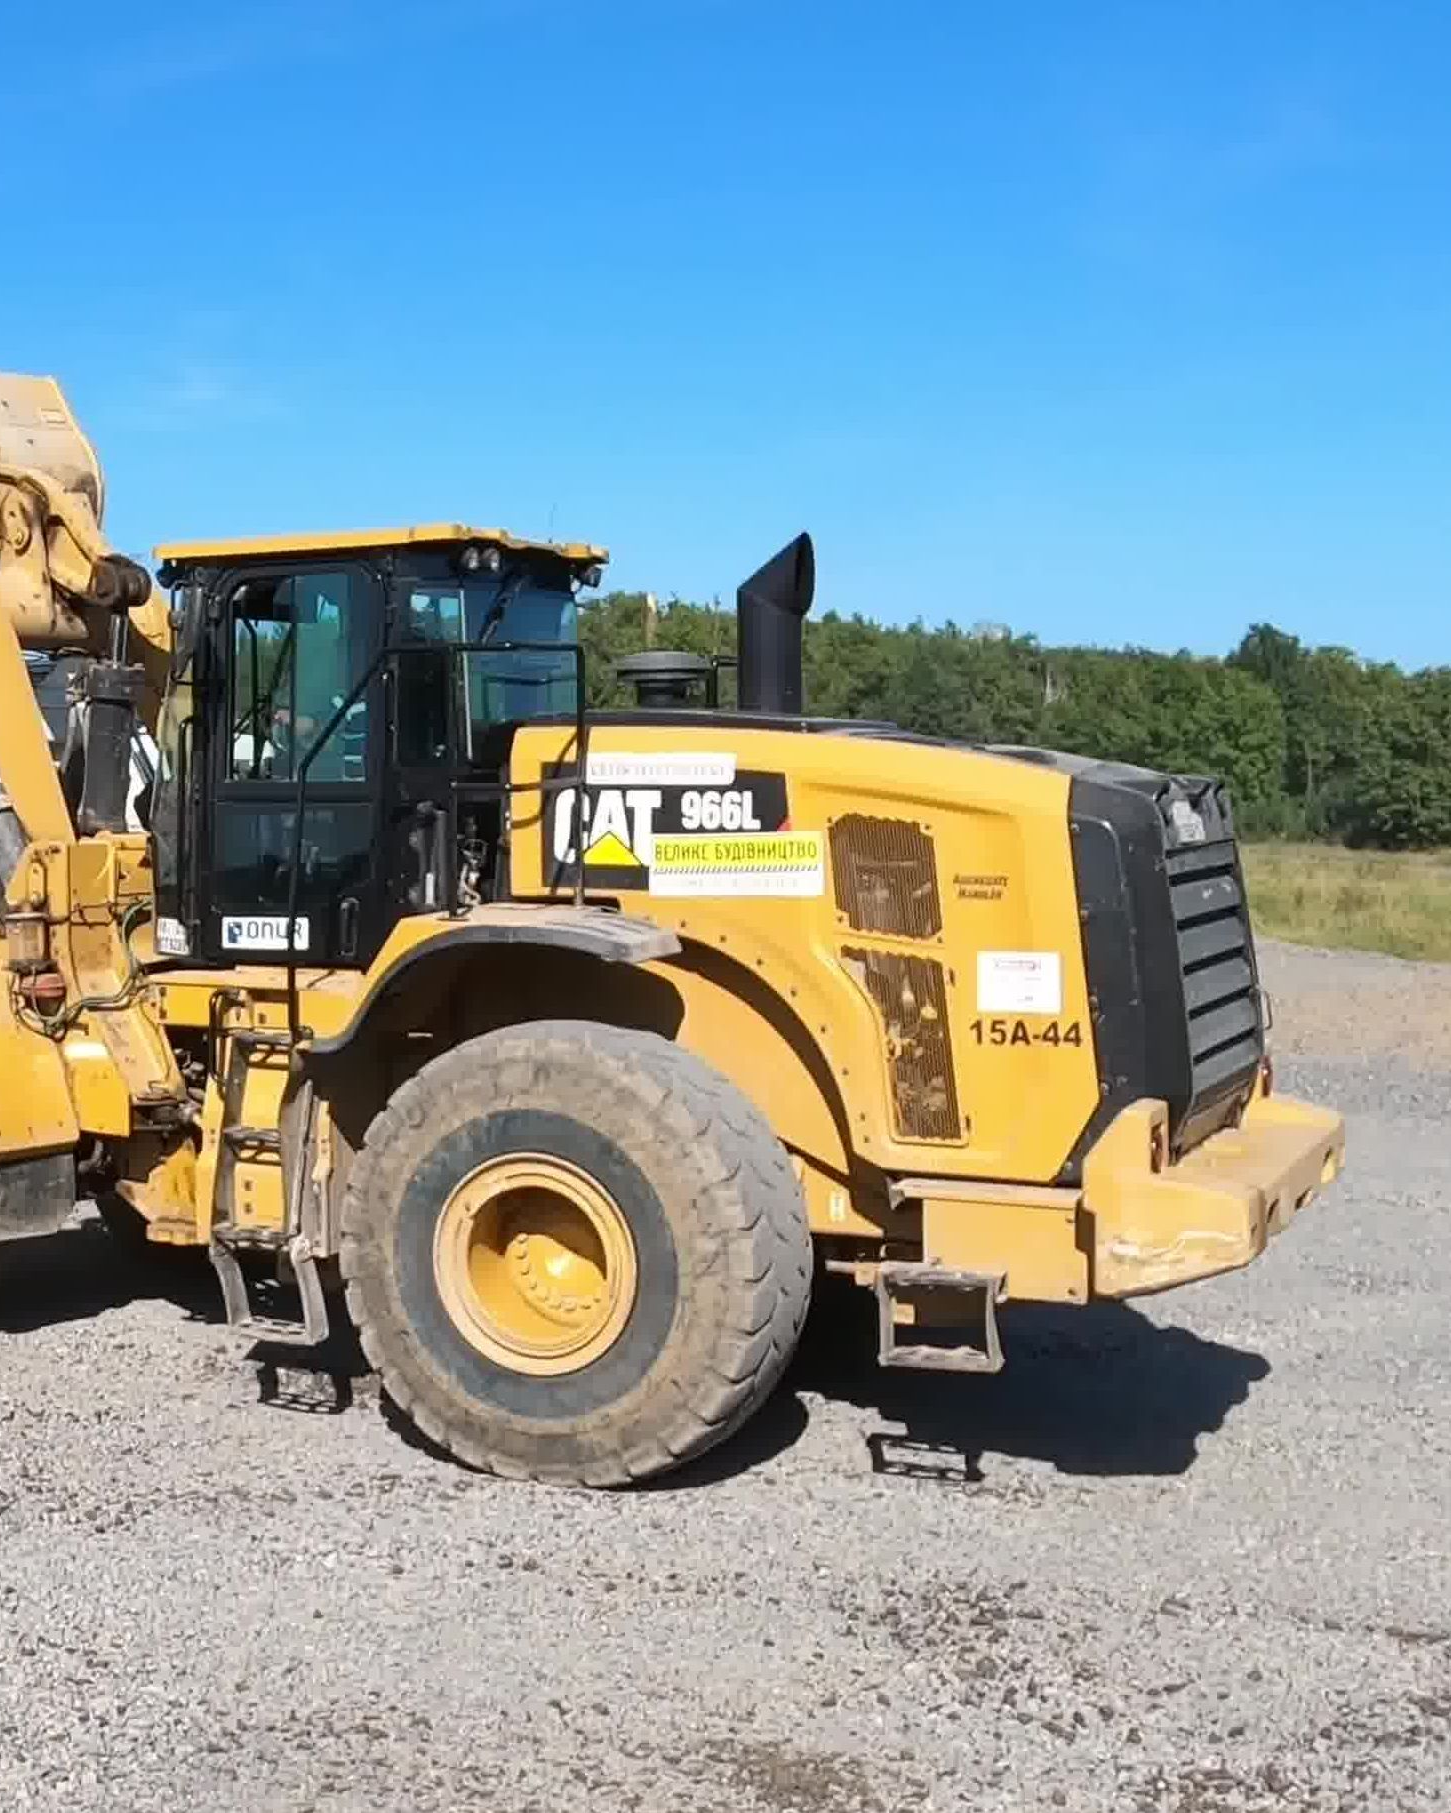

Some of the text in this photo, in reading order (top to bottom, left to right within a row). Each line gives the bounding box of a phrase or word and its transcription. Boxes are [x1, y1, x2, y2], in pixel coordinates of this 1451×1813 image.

[553, 788, 761, 867] CAT 966L
[654, 840, 818, 862] ВЕЛИКЕ БУДІВНИЦТВО
[968, 1020, 1083, 1048] 15A-44
